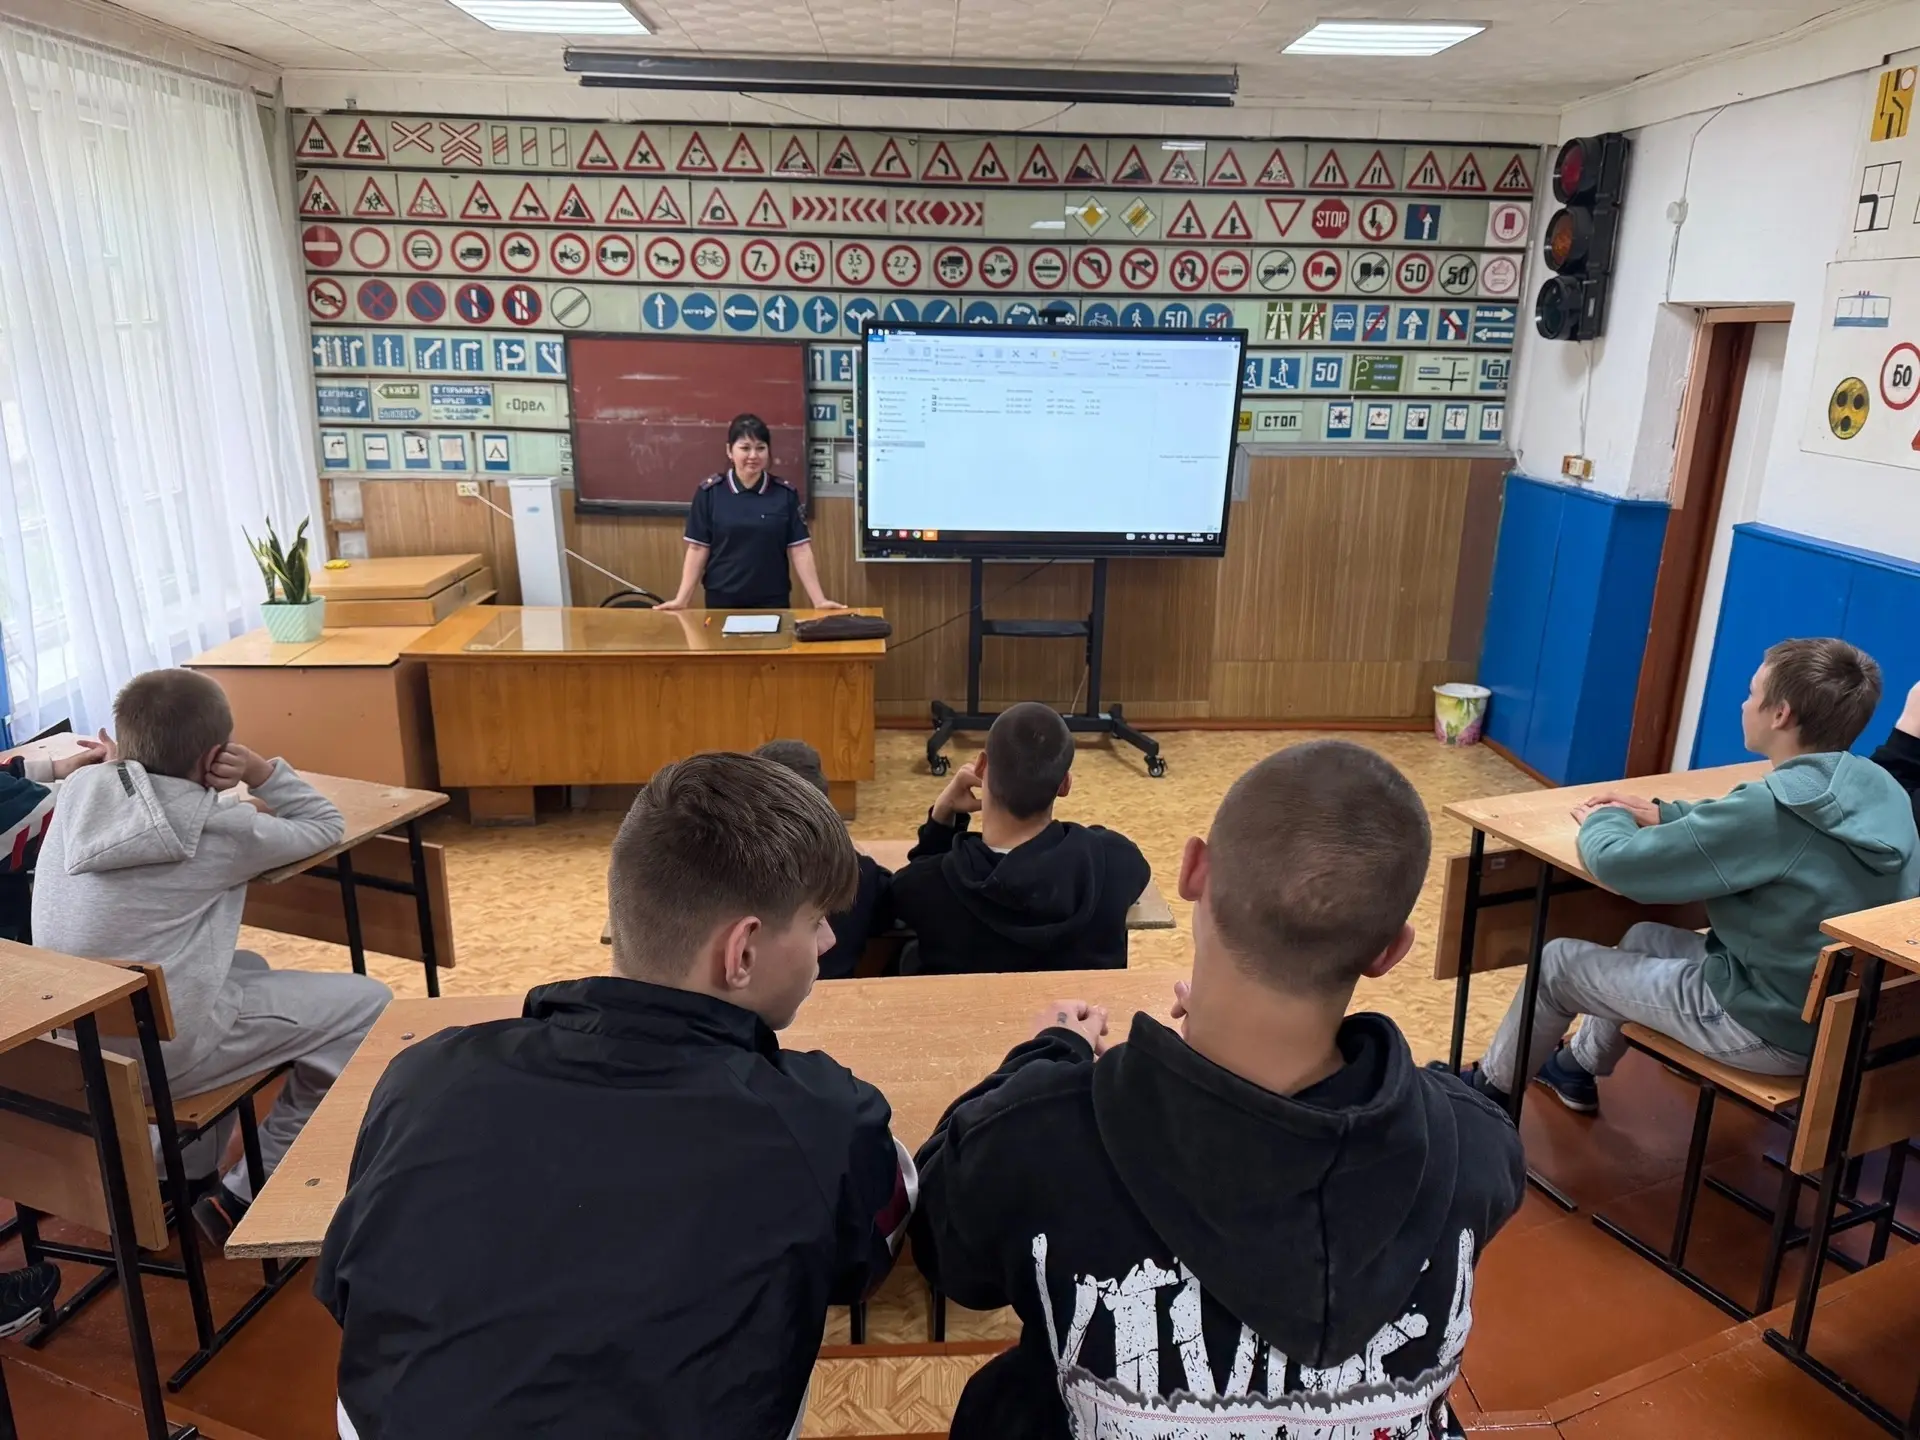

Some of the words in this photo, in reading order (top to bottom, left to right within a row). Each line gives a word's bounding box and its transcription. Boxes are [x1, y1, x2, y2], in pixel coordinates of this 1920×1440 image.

[1316, 210, 1347, 228] STOP
[1404, 263, 1427, 283] 50
[1447, 266, 1470, 286] 50
[1165, 310, 1188, 328] 50
[1315, 362, 1339, 383] 50
[512, 398, 546, 413] Орел
[813, 406, 831, 419] 171
[1263, 415, 1297, 428] СТОП
